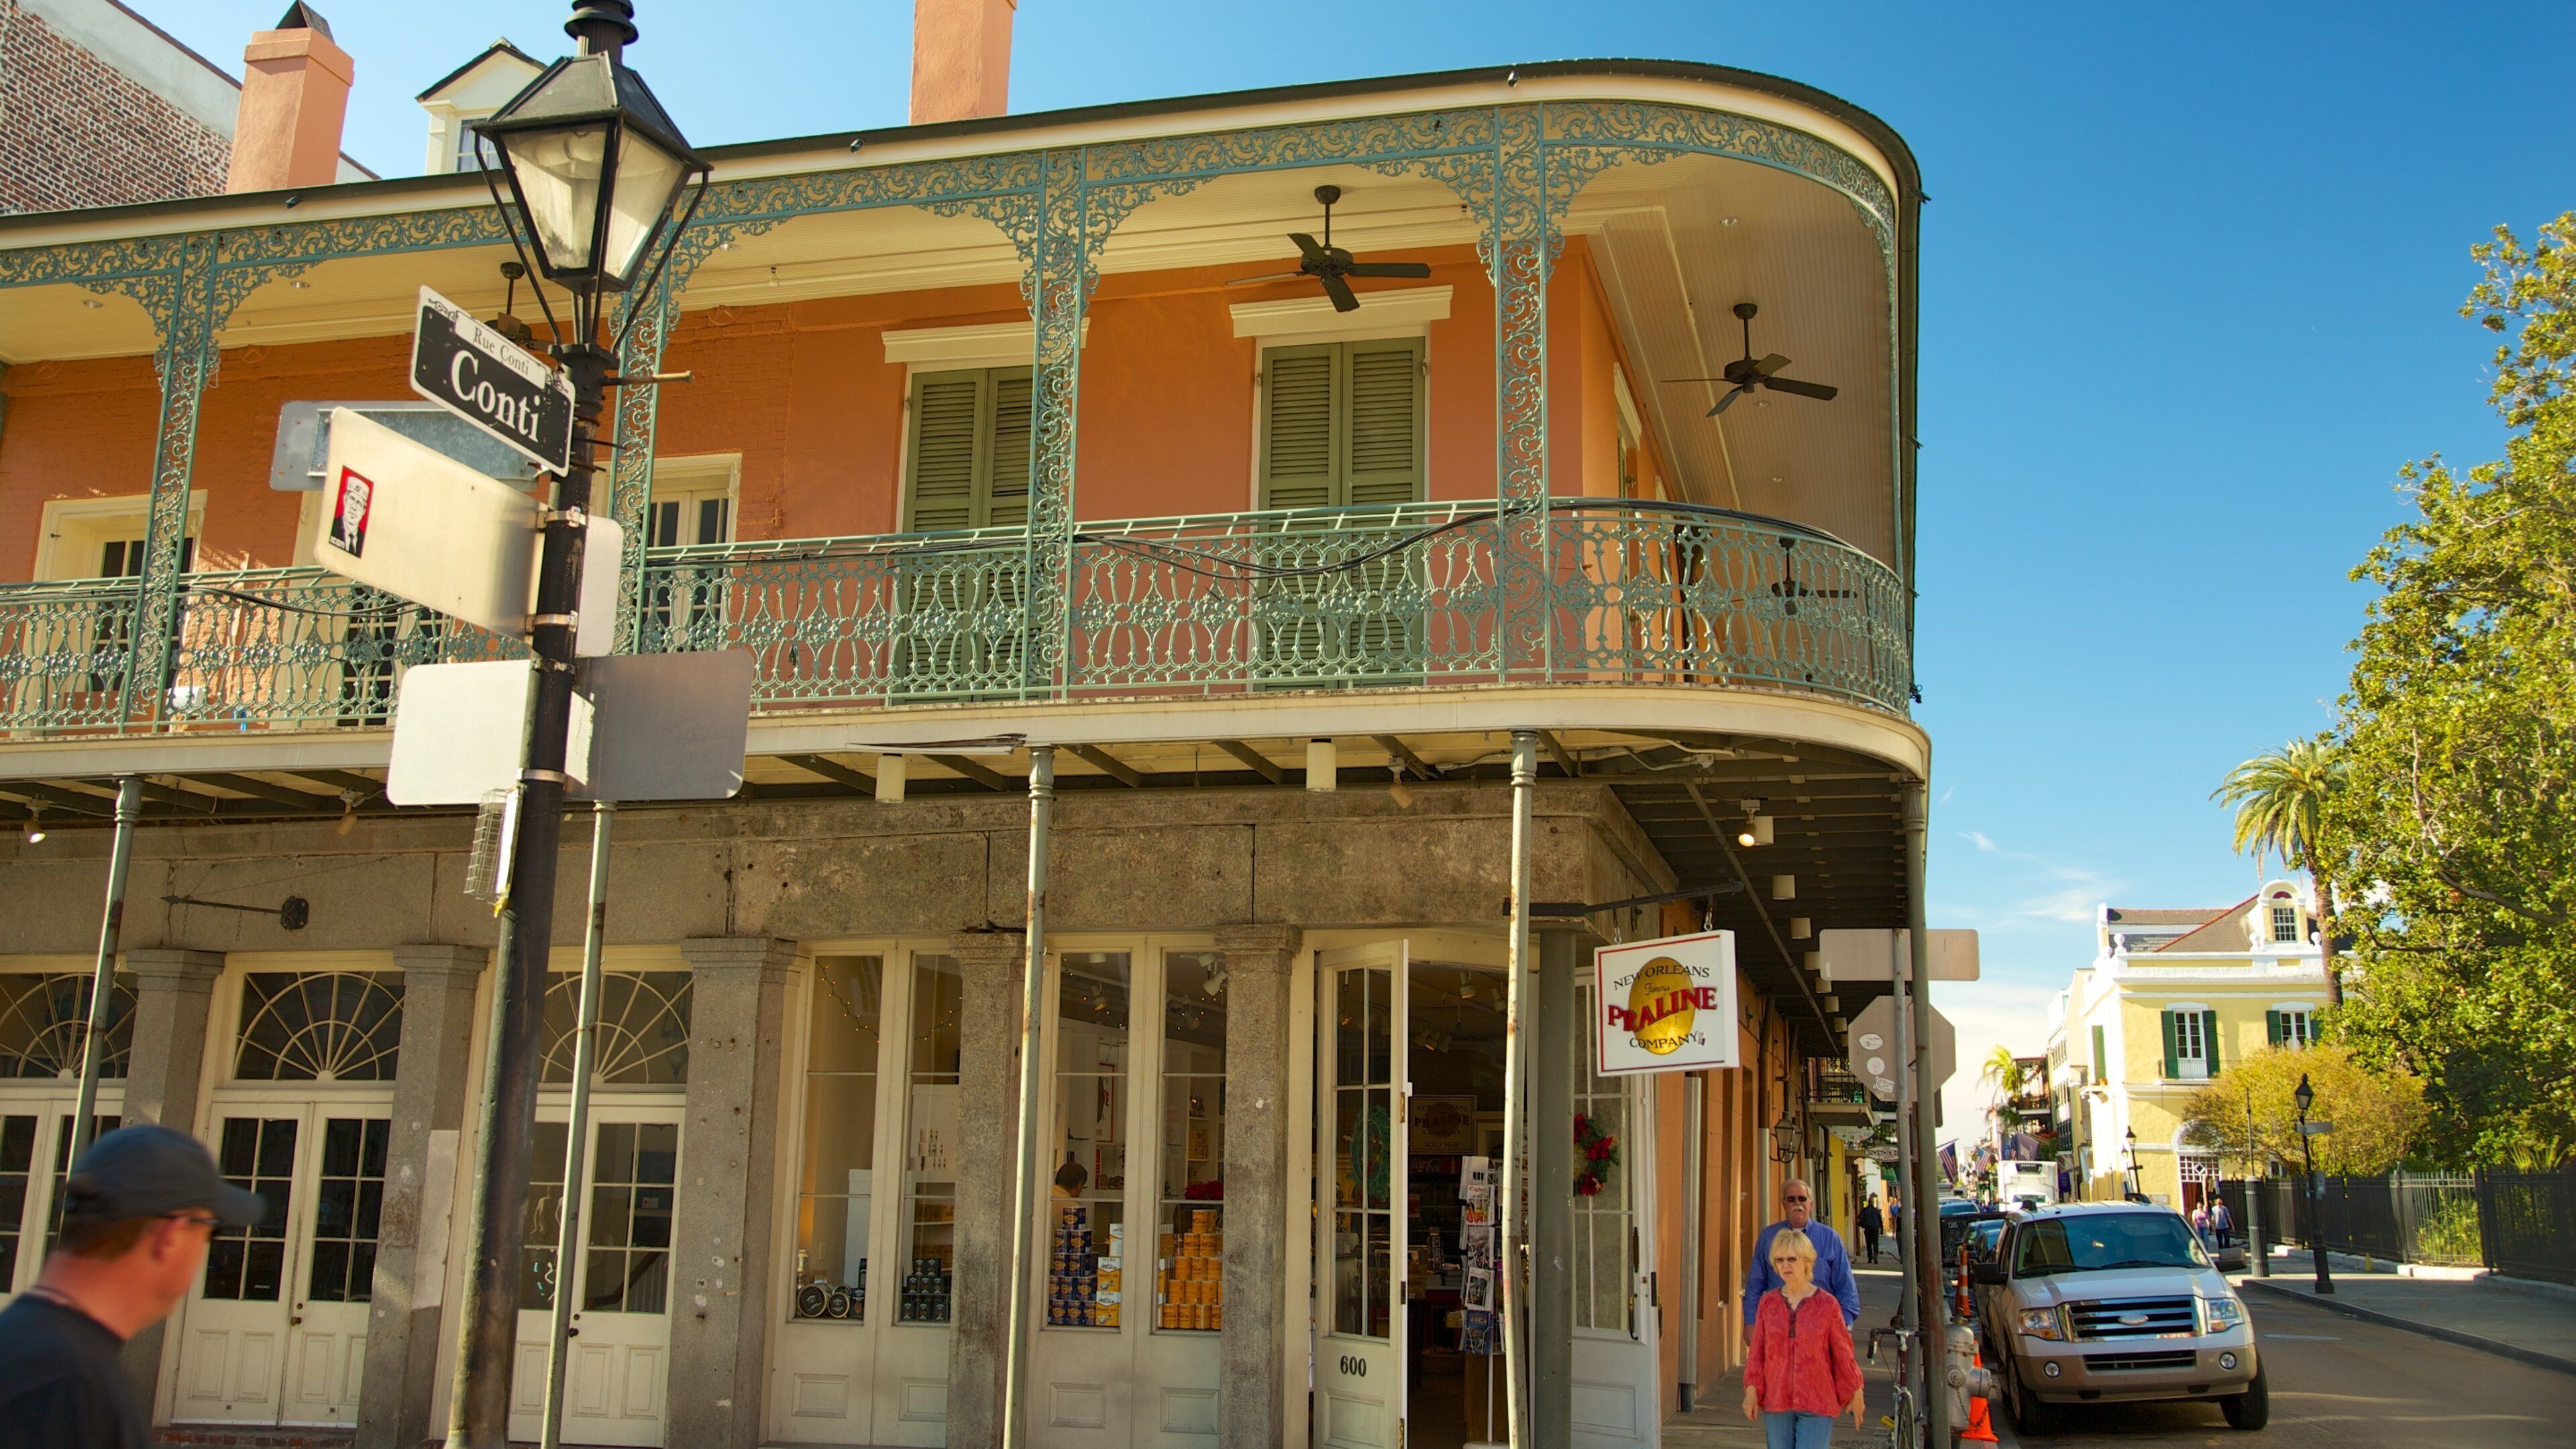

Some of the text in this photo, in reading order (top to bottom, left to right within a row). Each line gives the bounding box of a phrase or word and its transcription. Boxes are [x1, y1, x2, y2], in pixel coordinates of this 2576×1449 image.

[472, 326, 529, 376] Rue Conti
[451, 349, 539, 443] Conti
[1613, 965, 1710, 990] NEW ORLEANS
[1644, 982, 1670, 996] Famous
[1607, 987, 1718, 1032] PRALINE
[1629, 1030, 1699, 1049] COMPANY
[1414, 1114, 1469, 1128] PRALINE
[1340, 1355, 1366, 1377] 600
